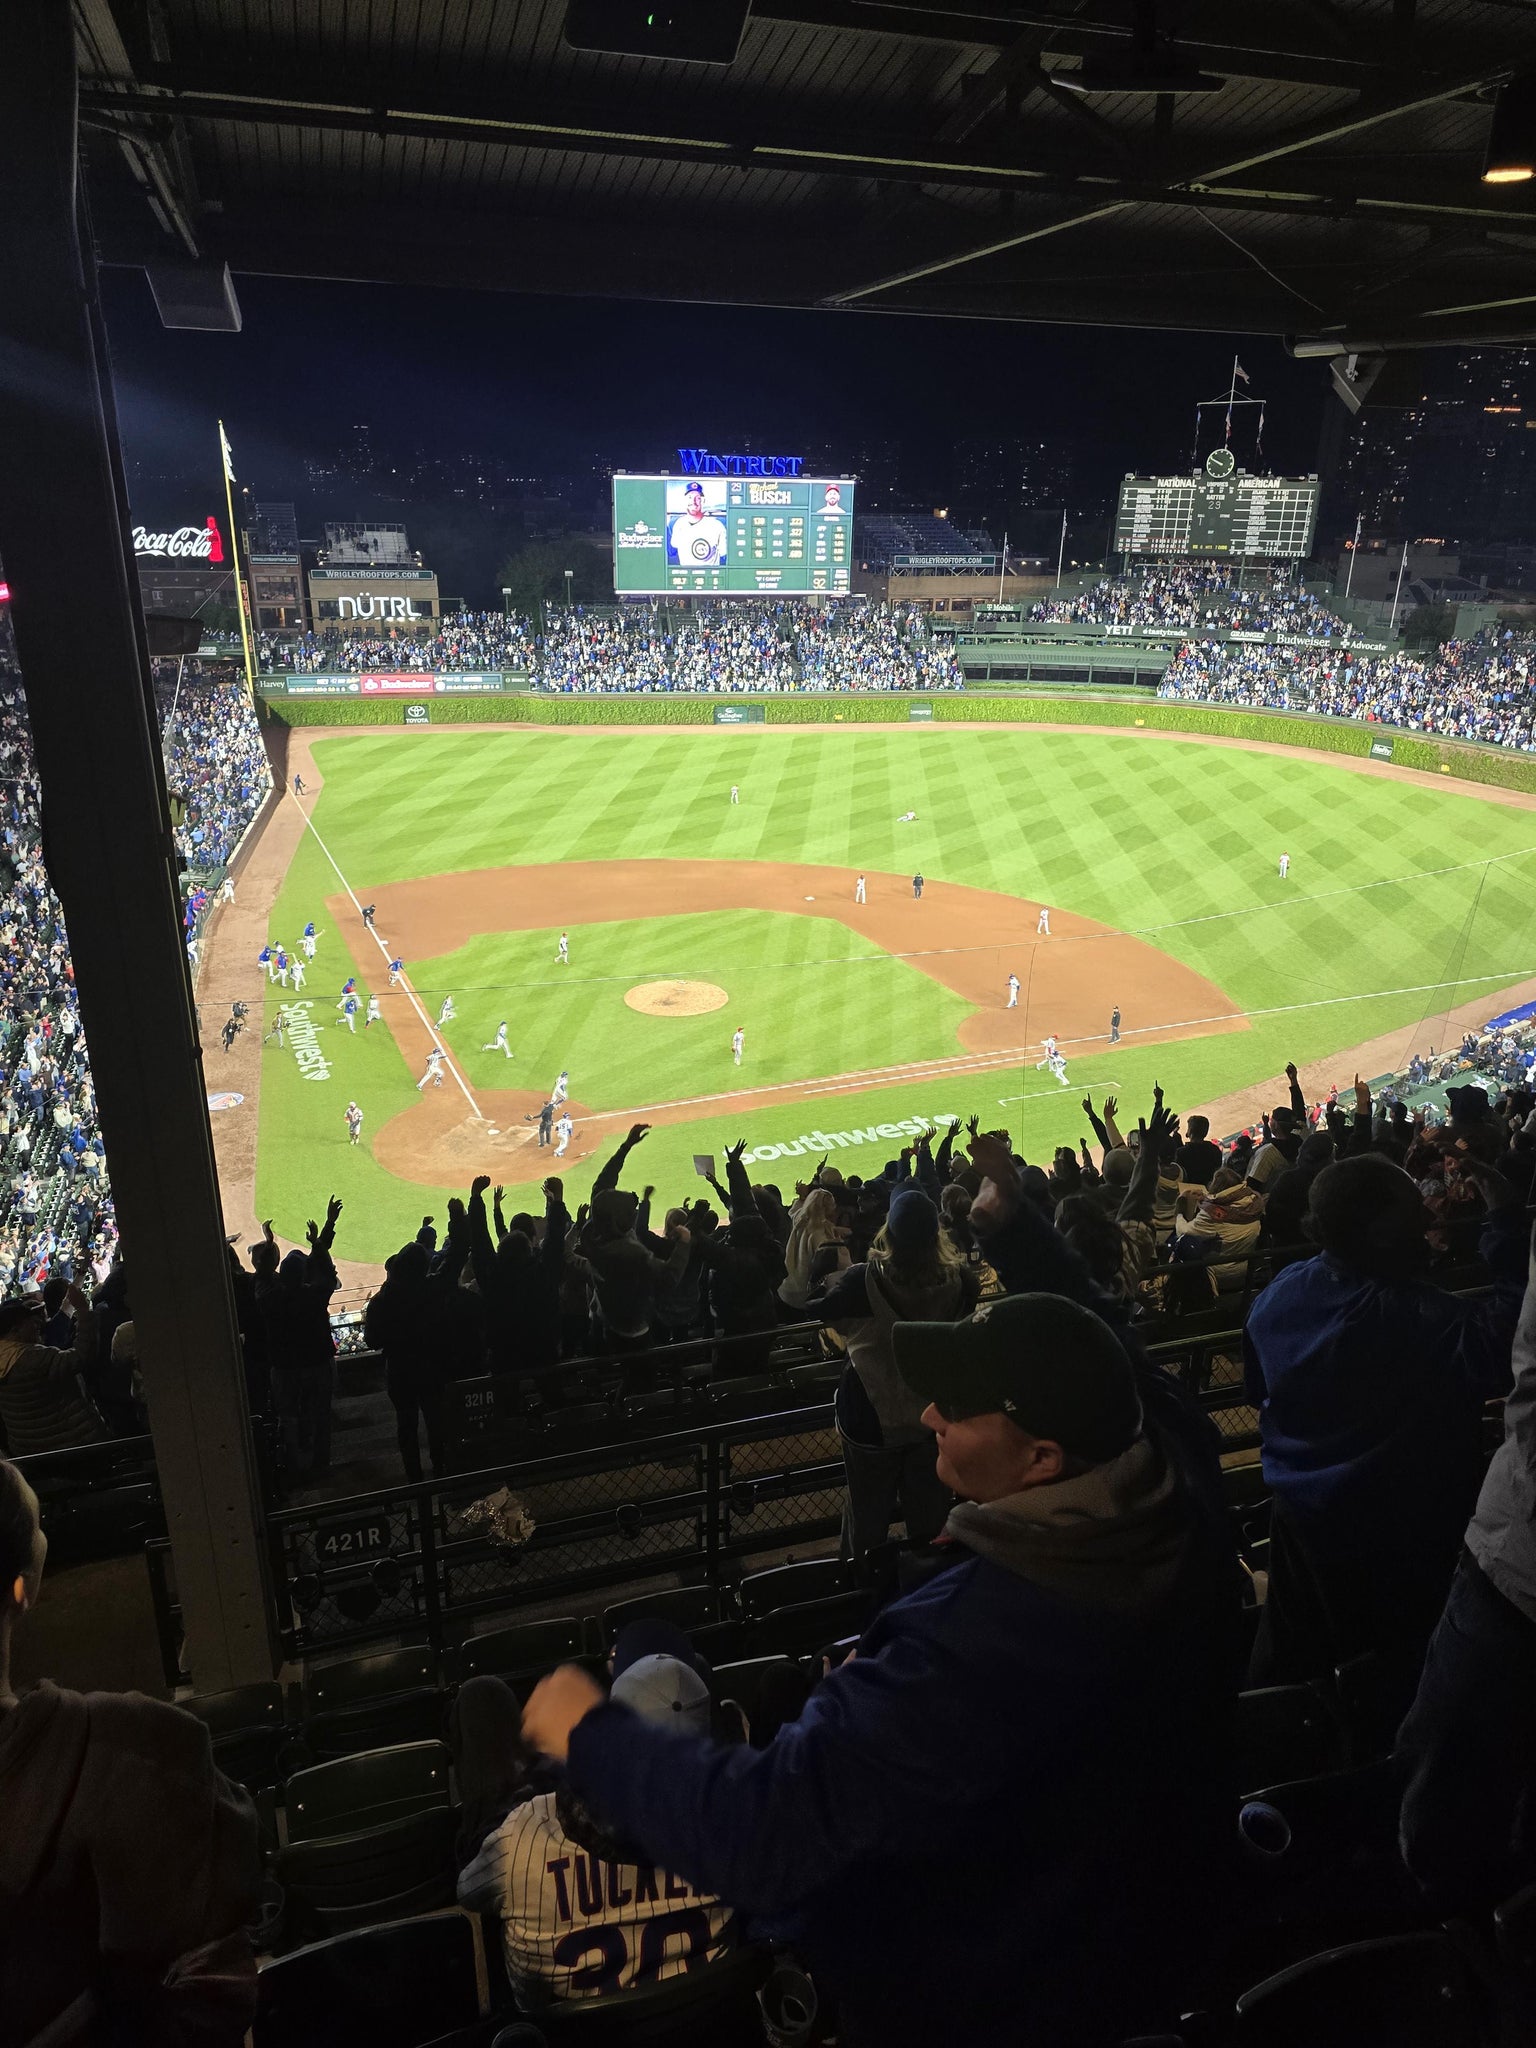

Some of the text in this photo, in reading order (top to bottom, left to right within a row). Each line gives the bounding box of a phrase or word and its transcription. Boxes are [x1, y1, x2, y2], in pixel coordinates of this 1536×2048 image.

[677, 448, 802, 477] WINTRUST
[732, 483, 742, 492] 29
[1157, 478, 1197, 488] NATIONAL
[1238, 479, 1280, 489] AMERICAN
[750, 491, 791, 504] BUSCH
[1208, 501, 1220, 509] 29
[813, 578, 826, 589] 92
[1105, 626, 1134, 635] YETI
[1148, 628, 1187, 637] tastytrade
[1230, 630, 1266, 638] GRAINGER
[1276, 634, 1330, 647] Budweiser
[1350, 641, 1388, 651] Advocate
[260, 680, 285, 688] Harvey
[380, 680, 430, 689] Budweiser
[280, 1001, 332, 1072] Southwest
[325, 1526, 382, 1553] 421R
